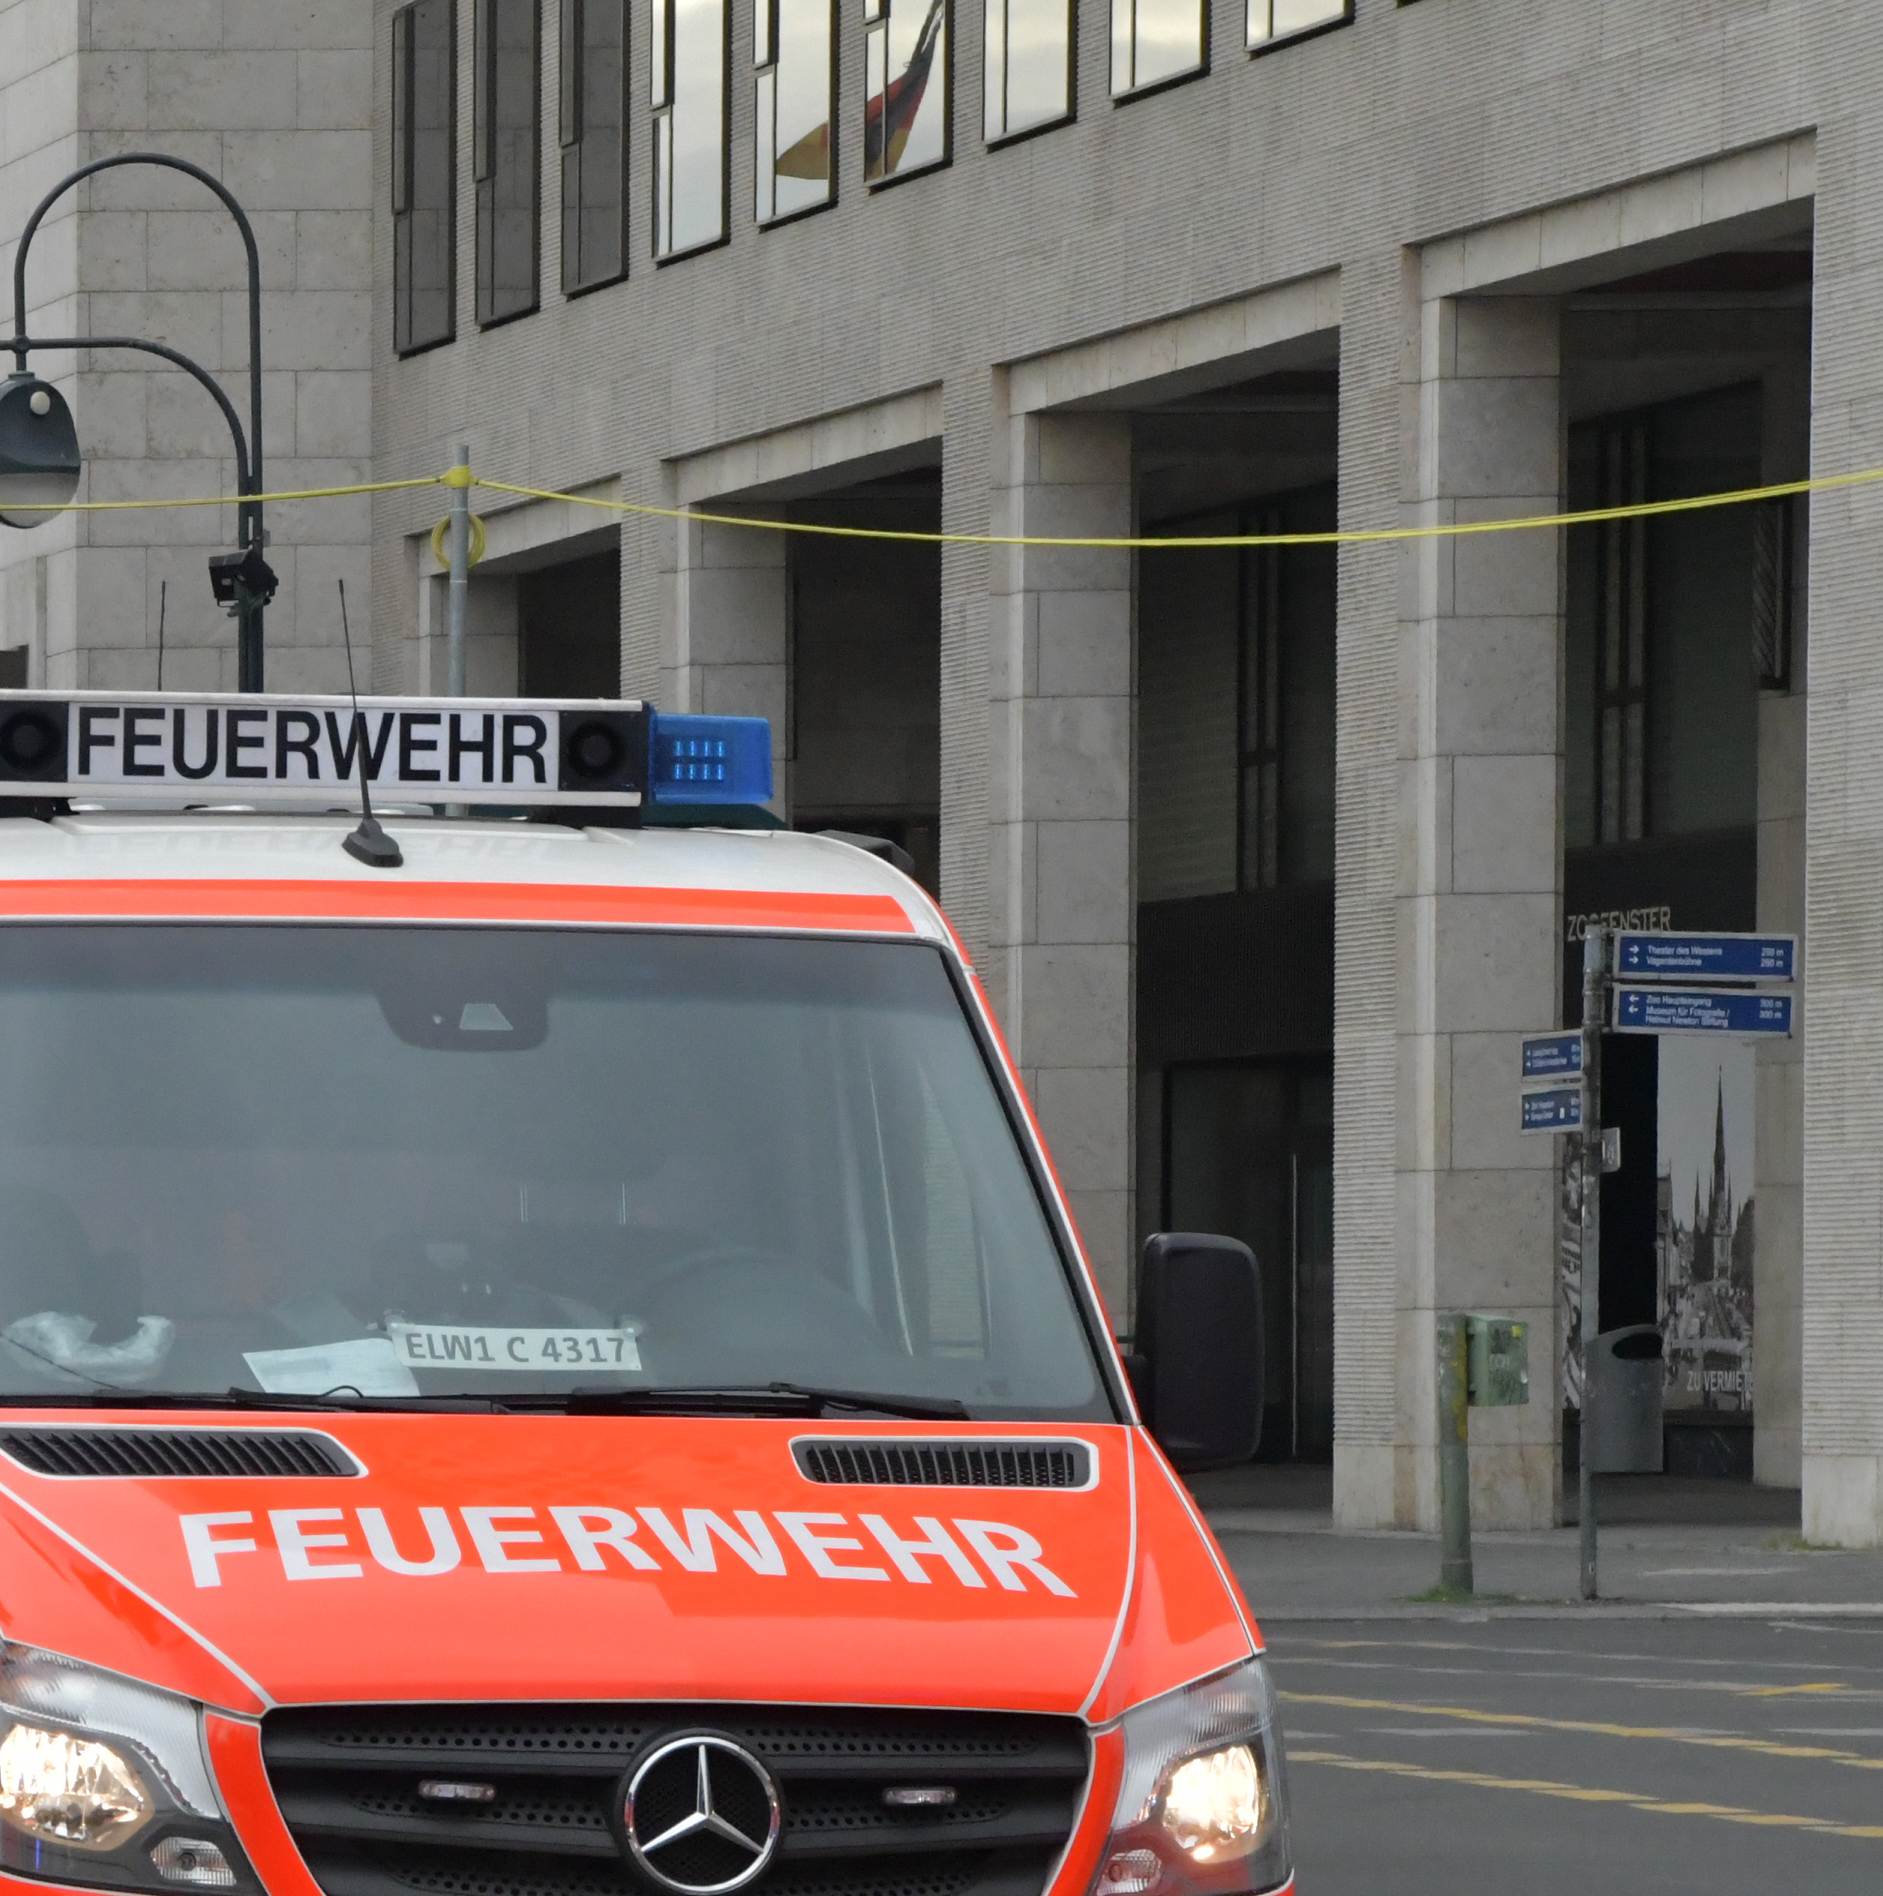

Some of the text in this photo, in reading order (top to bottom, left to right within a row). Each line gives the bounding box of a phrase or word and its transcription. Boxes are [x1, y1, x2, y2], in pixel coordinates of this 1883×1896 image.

[78, 706, 548, 783] FEUERWEHR
[405, 1332, 624, 1364] ELW1 C 4317
[178, 1506, 1080, 1599] FEUERWEHR
